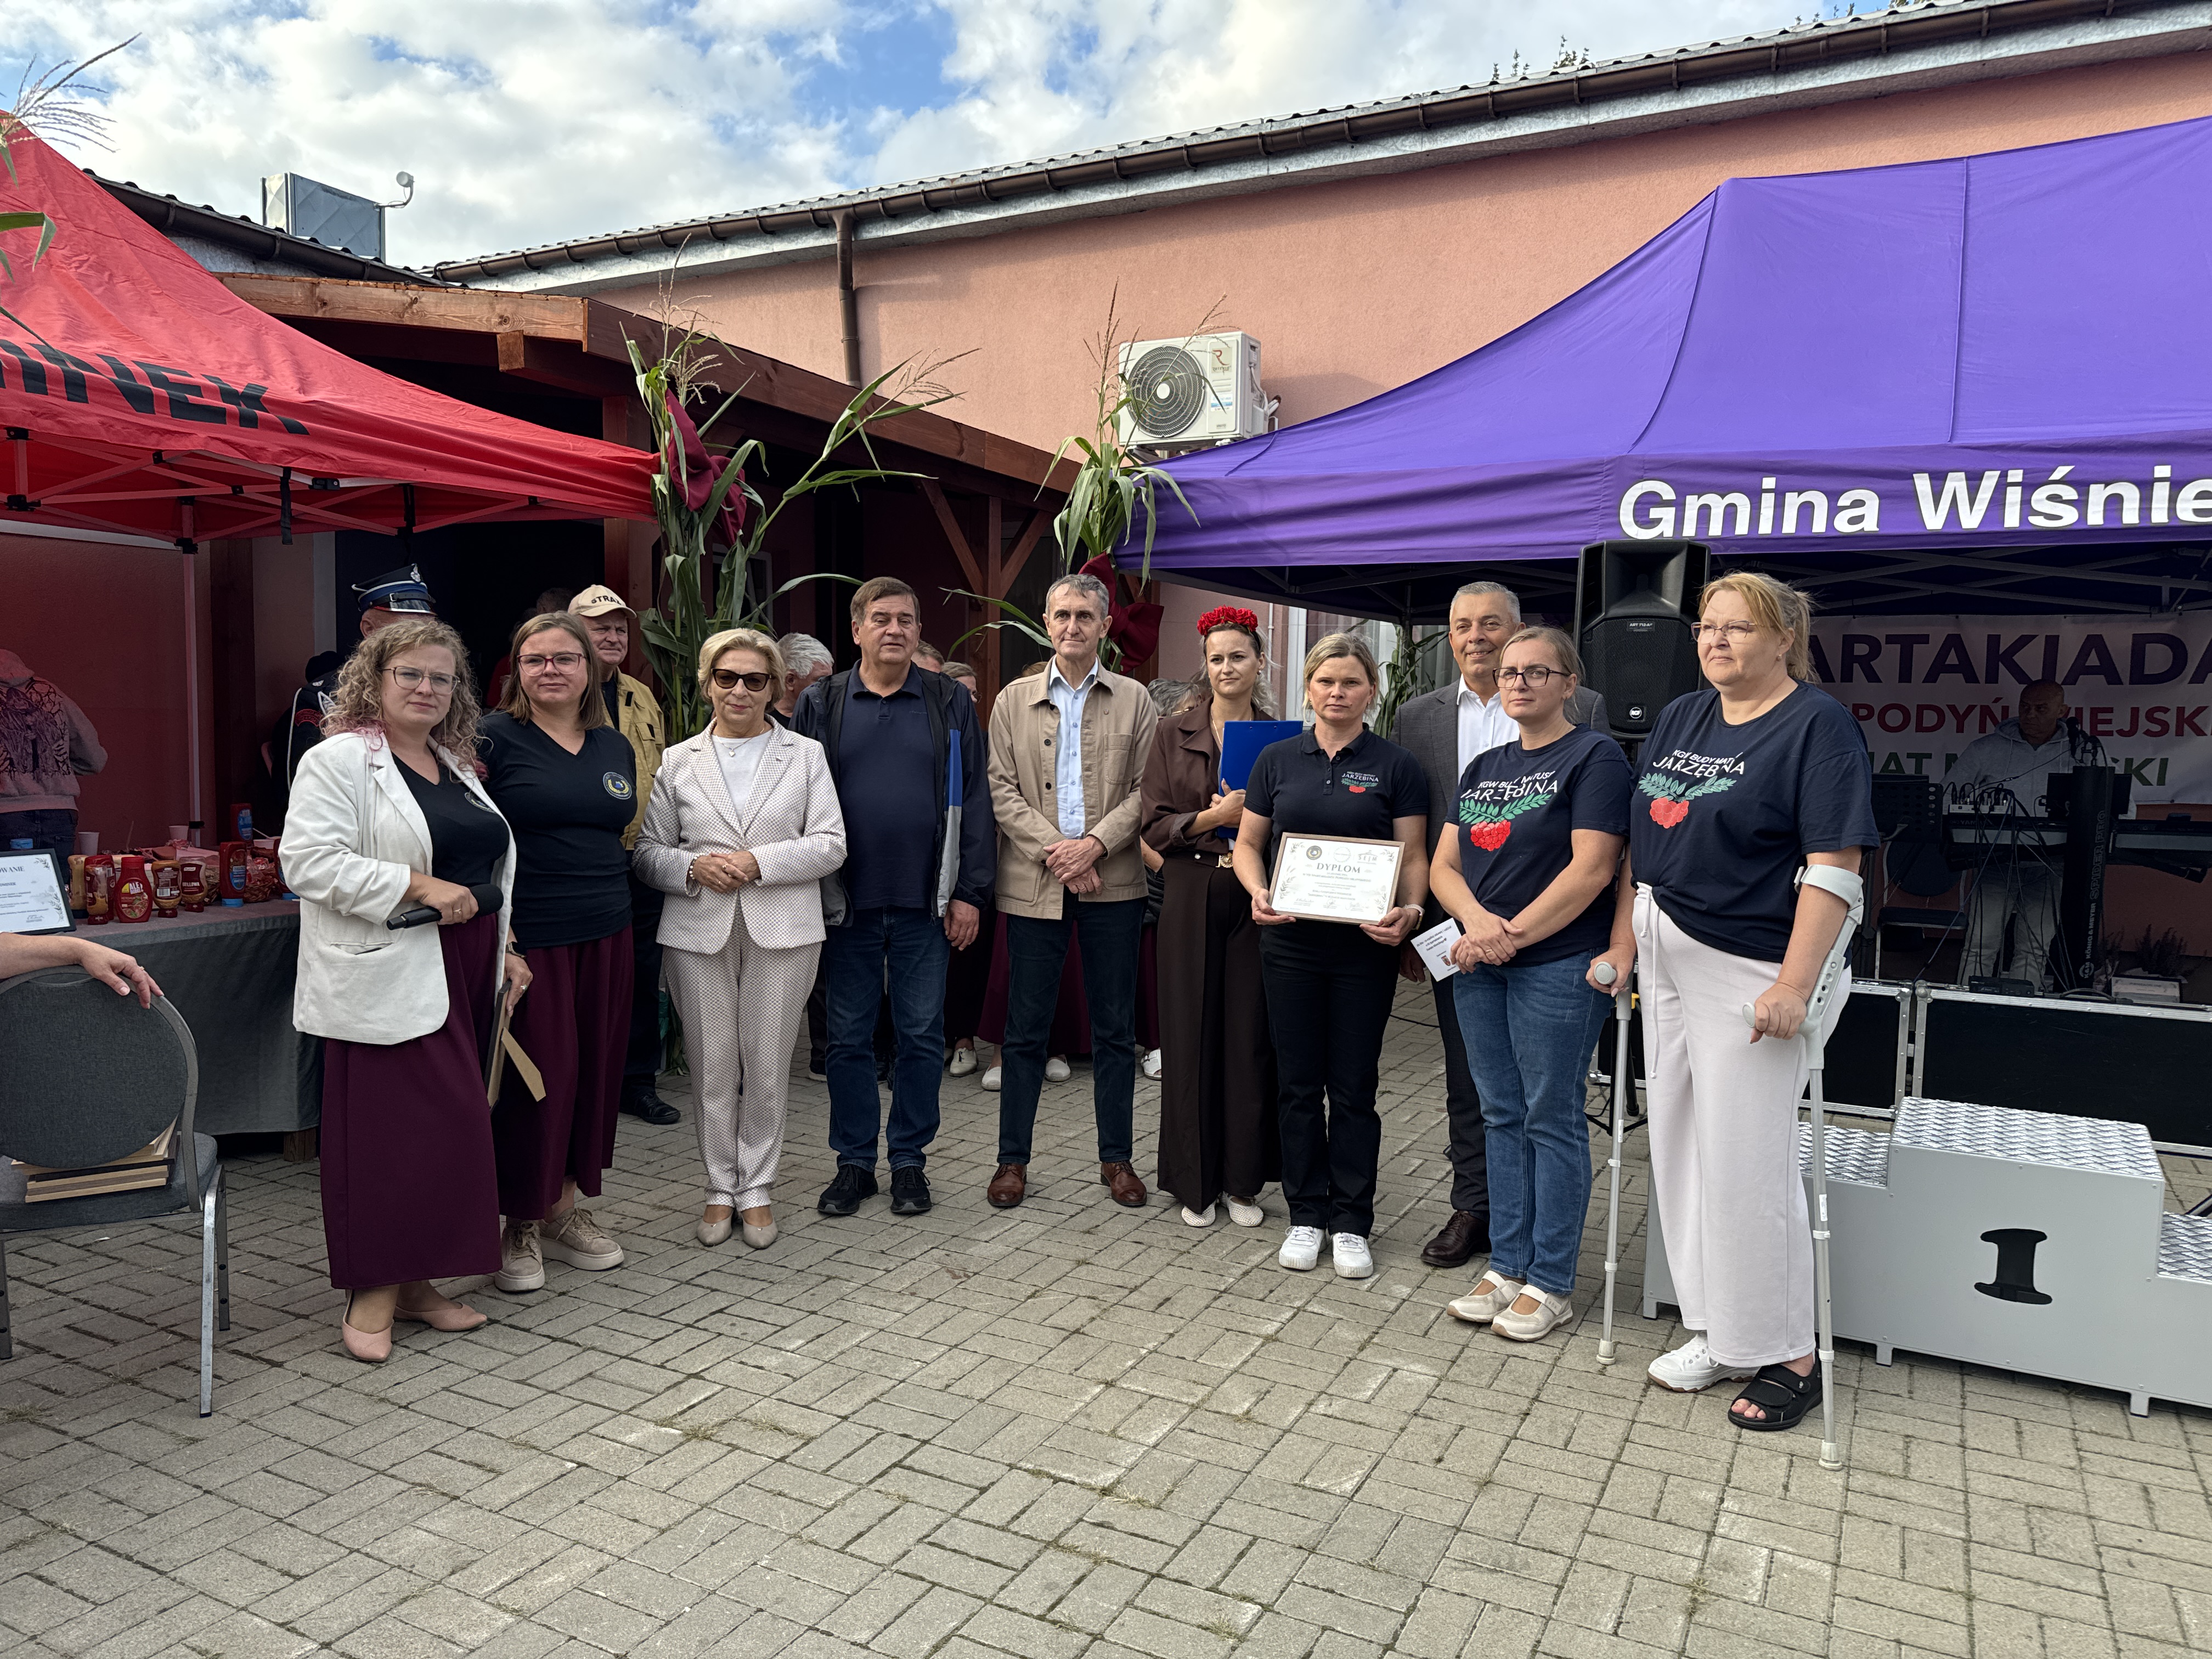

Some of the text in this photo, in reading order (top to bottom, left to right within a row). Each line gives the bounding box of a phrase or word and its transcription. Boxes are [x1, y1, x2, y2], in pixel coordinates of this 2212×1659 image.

[1620, 477, 1880, 540] Gmina
[1842, 697, 2212, 737] PODYŃ IEJSK
[1653, 757, 1745, 778] JARZĘBNA
[1690, 754, 1717, 764] BUDY
[1477, 781, 1499, 789] KGW
[1317, 862, 1361, 873] DYPLOM
[1974, 1228, 2053, 1305] 1
